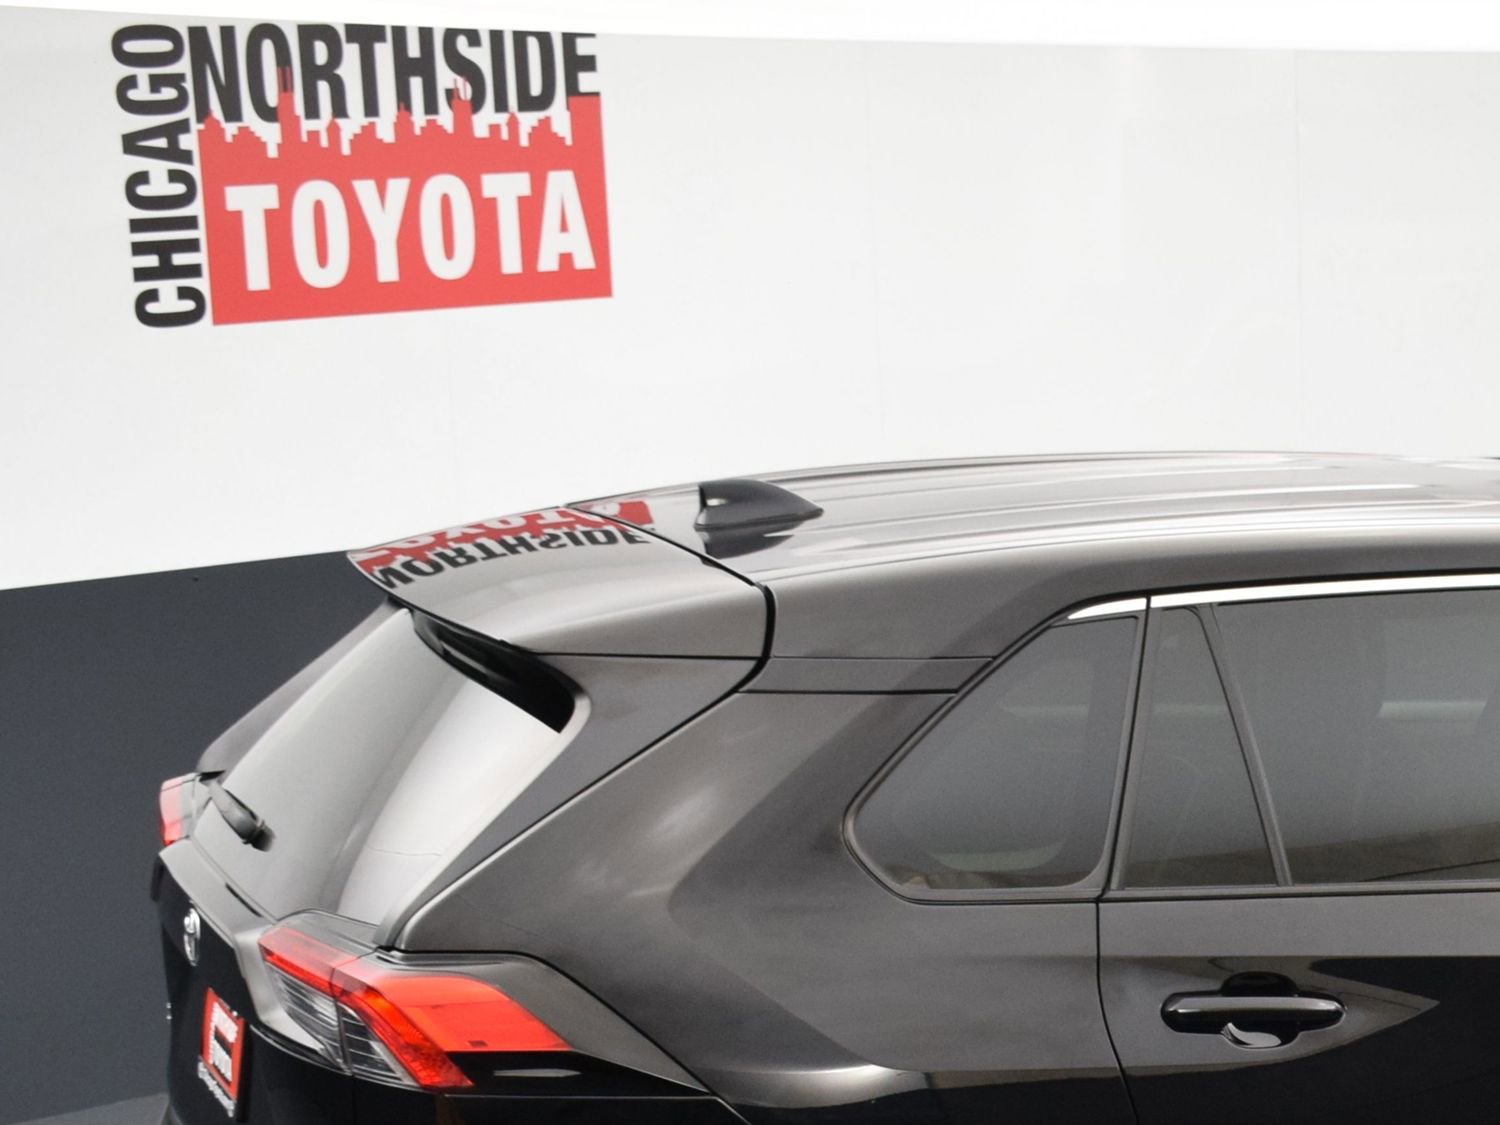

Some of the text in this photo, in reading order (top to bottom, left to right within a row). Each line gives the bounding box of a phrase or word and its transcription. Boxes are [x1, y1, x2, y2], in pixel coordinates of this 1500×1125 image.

[188, 23, 599, 124] NORTHSIDE
[111, 24, 207, 328] CHICAGO
[224, 170, 597, 291] TOYOTA
